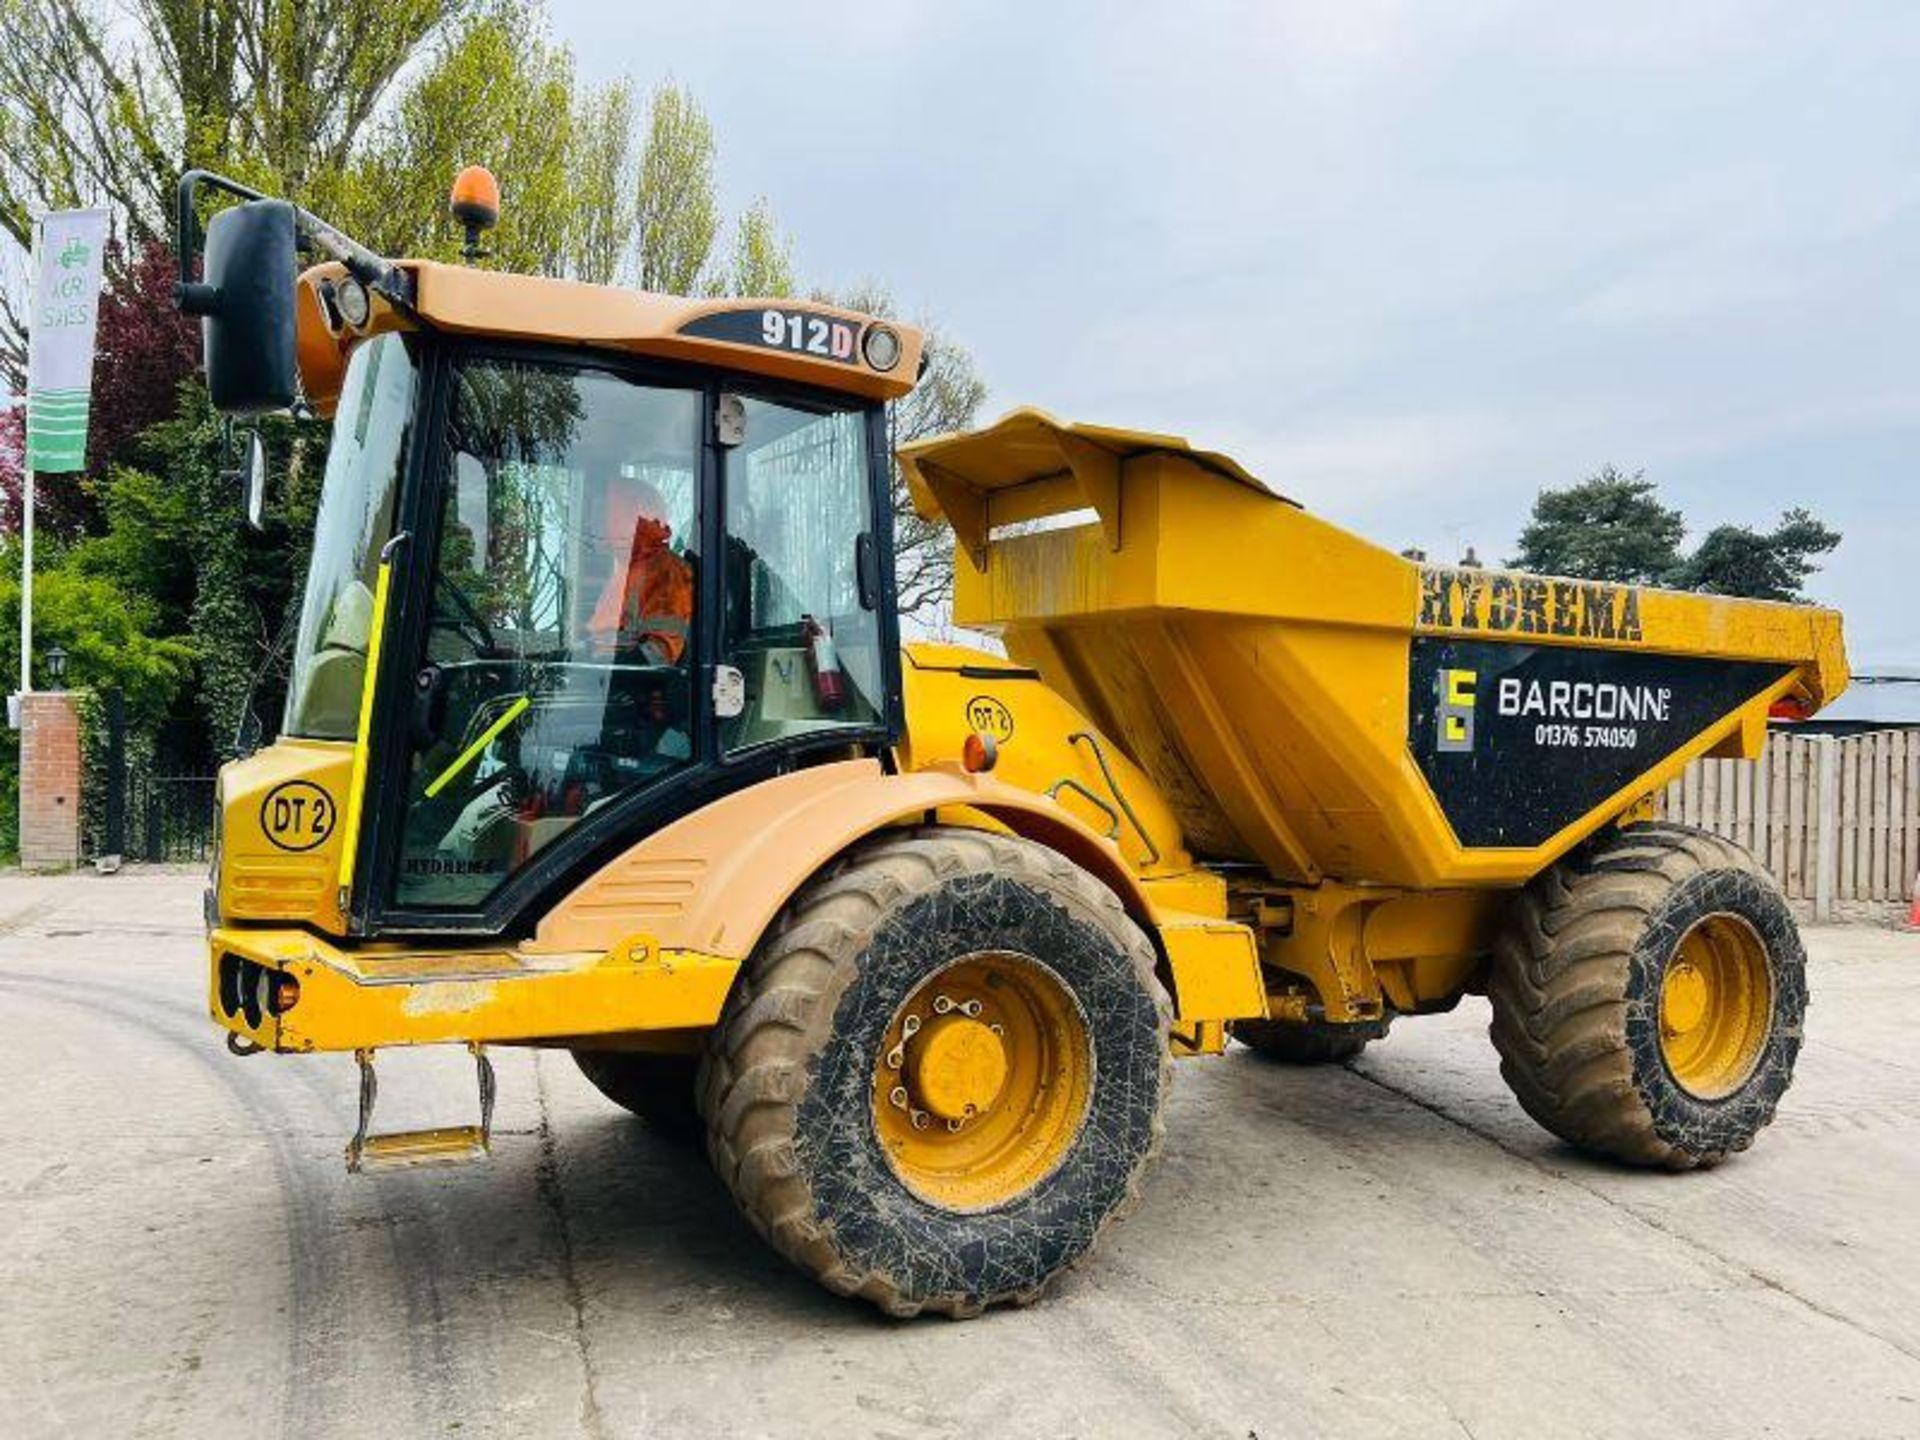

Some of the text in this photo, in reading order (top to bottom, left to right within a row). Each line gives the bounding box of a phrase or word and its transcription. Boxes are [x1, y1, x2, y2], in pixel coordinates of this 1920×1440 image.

[762, 309, 853, 359] 912D
[1418, 566, 1642, 641] HYDREMA
[1498, 677, 1662, 721] BARCONN
[1535, 724, 1638, 749] 01376 574050
[274, 797, 325, 833] DT 2
